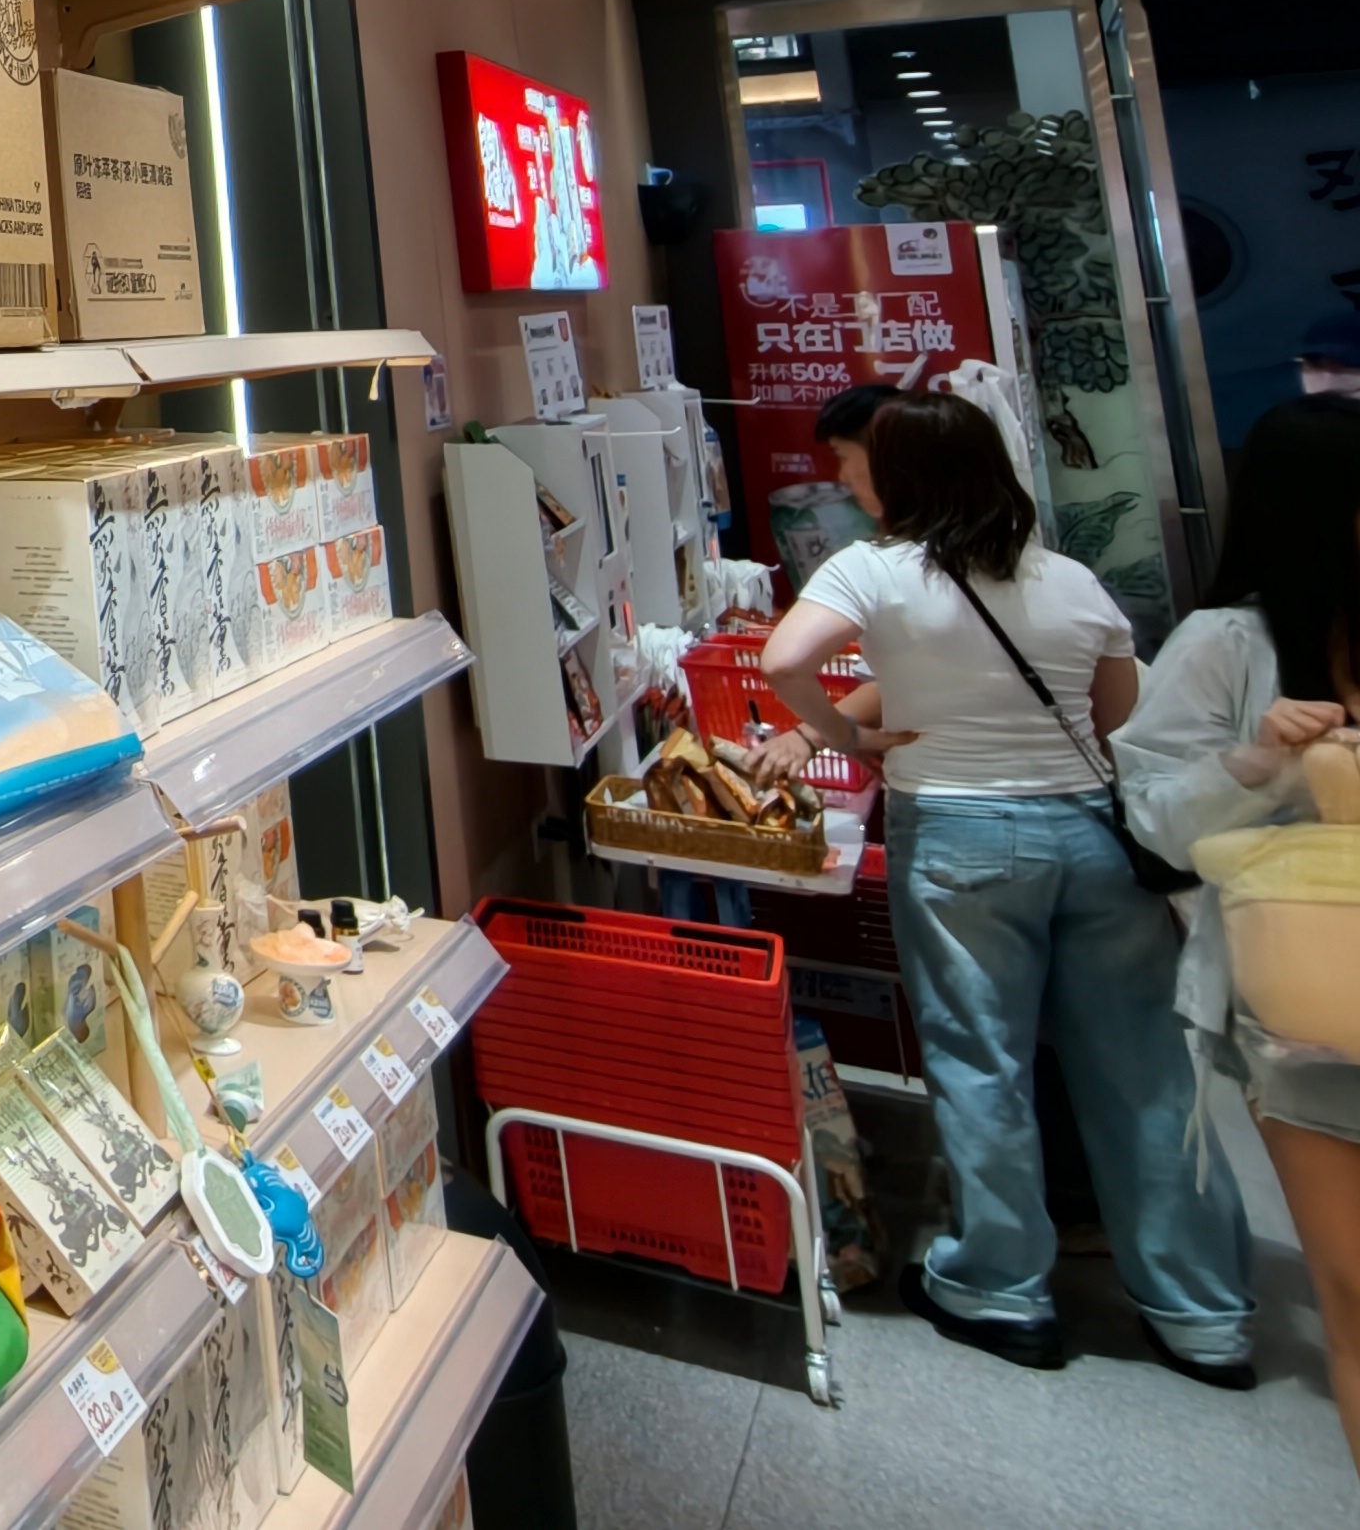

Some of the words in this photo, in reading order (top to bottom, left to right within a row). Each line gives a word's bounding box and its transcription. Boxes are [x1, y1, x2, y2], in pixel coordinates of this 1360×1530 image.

[756, 319, 956, 353] 只在门店做
